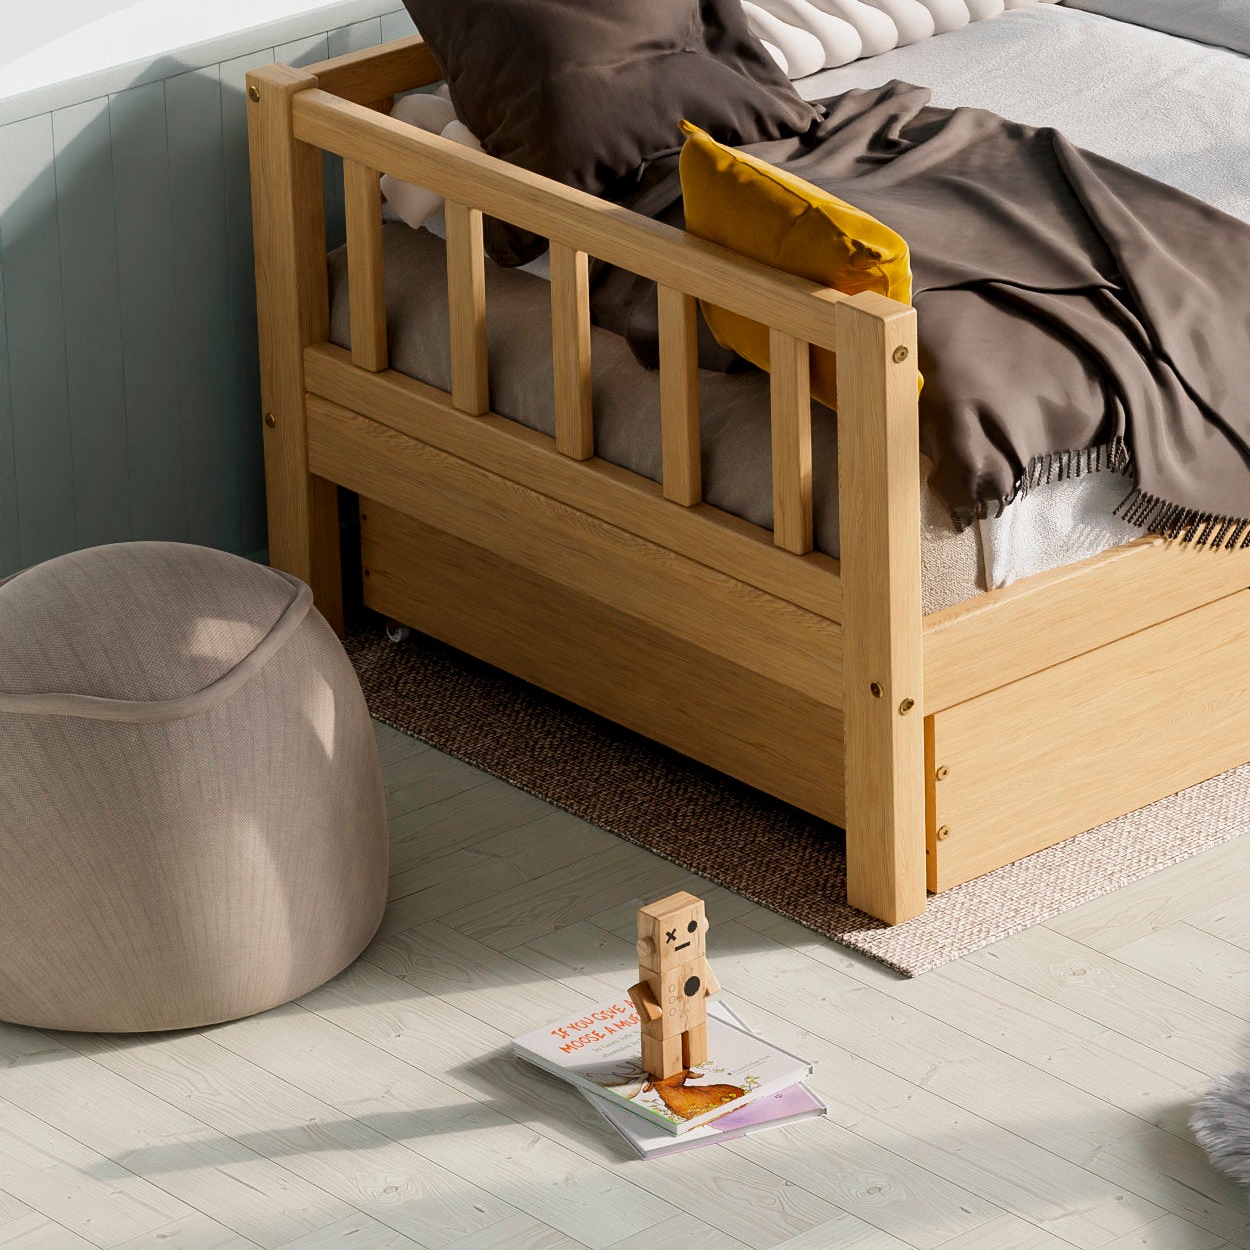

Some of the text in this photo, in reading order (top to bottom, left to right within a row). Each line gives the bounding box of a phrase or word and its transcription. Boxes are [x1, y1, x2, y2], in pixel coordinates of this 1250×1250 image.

[550, 1027, 571, 1039] IF
[567, 1016, 595, 1031] YOU
[591, 1004, 626, 1021] GIVE
[559, 1030, 606, 1054] MOOSE
[604, 1026, 617, 1035] A
